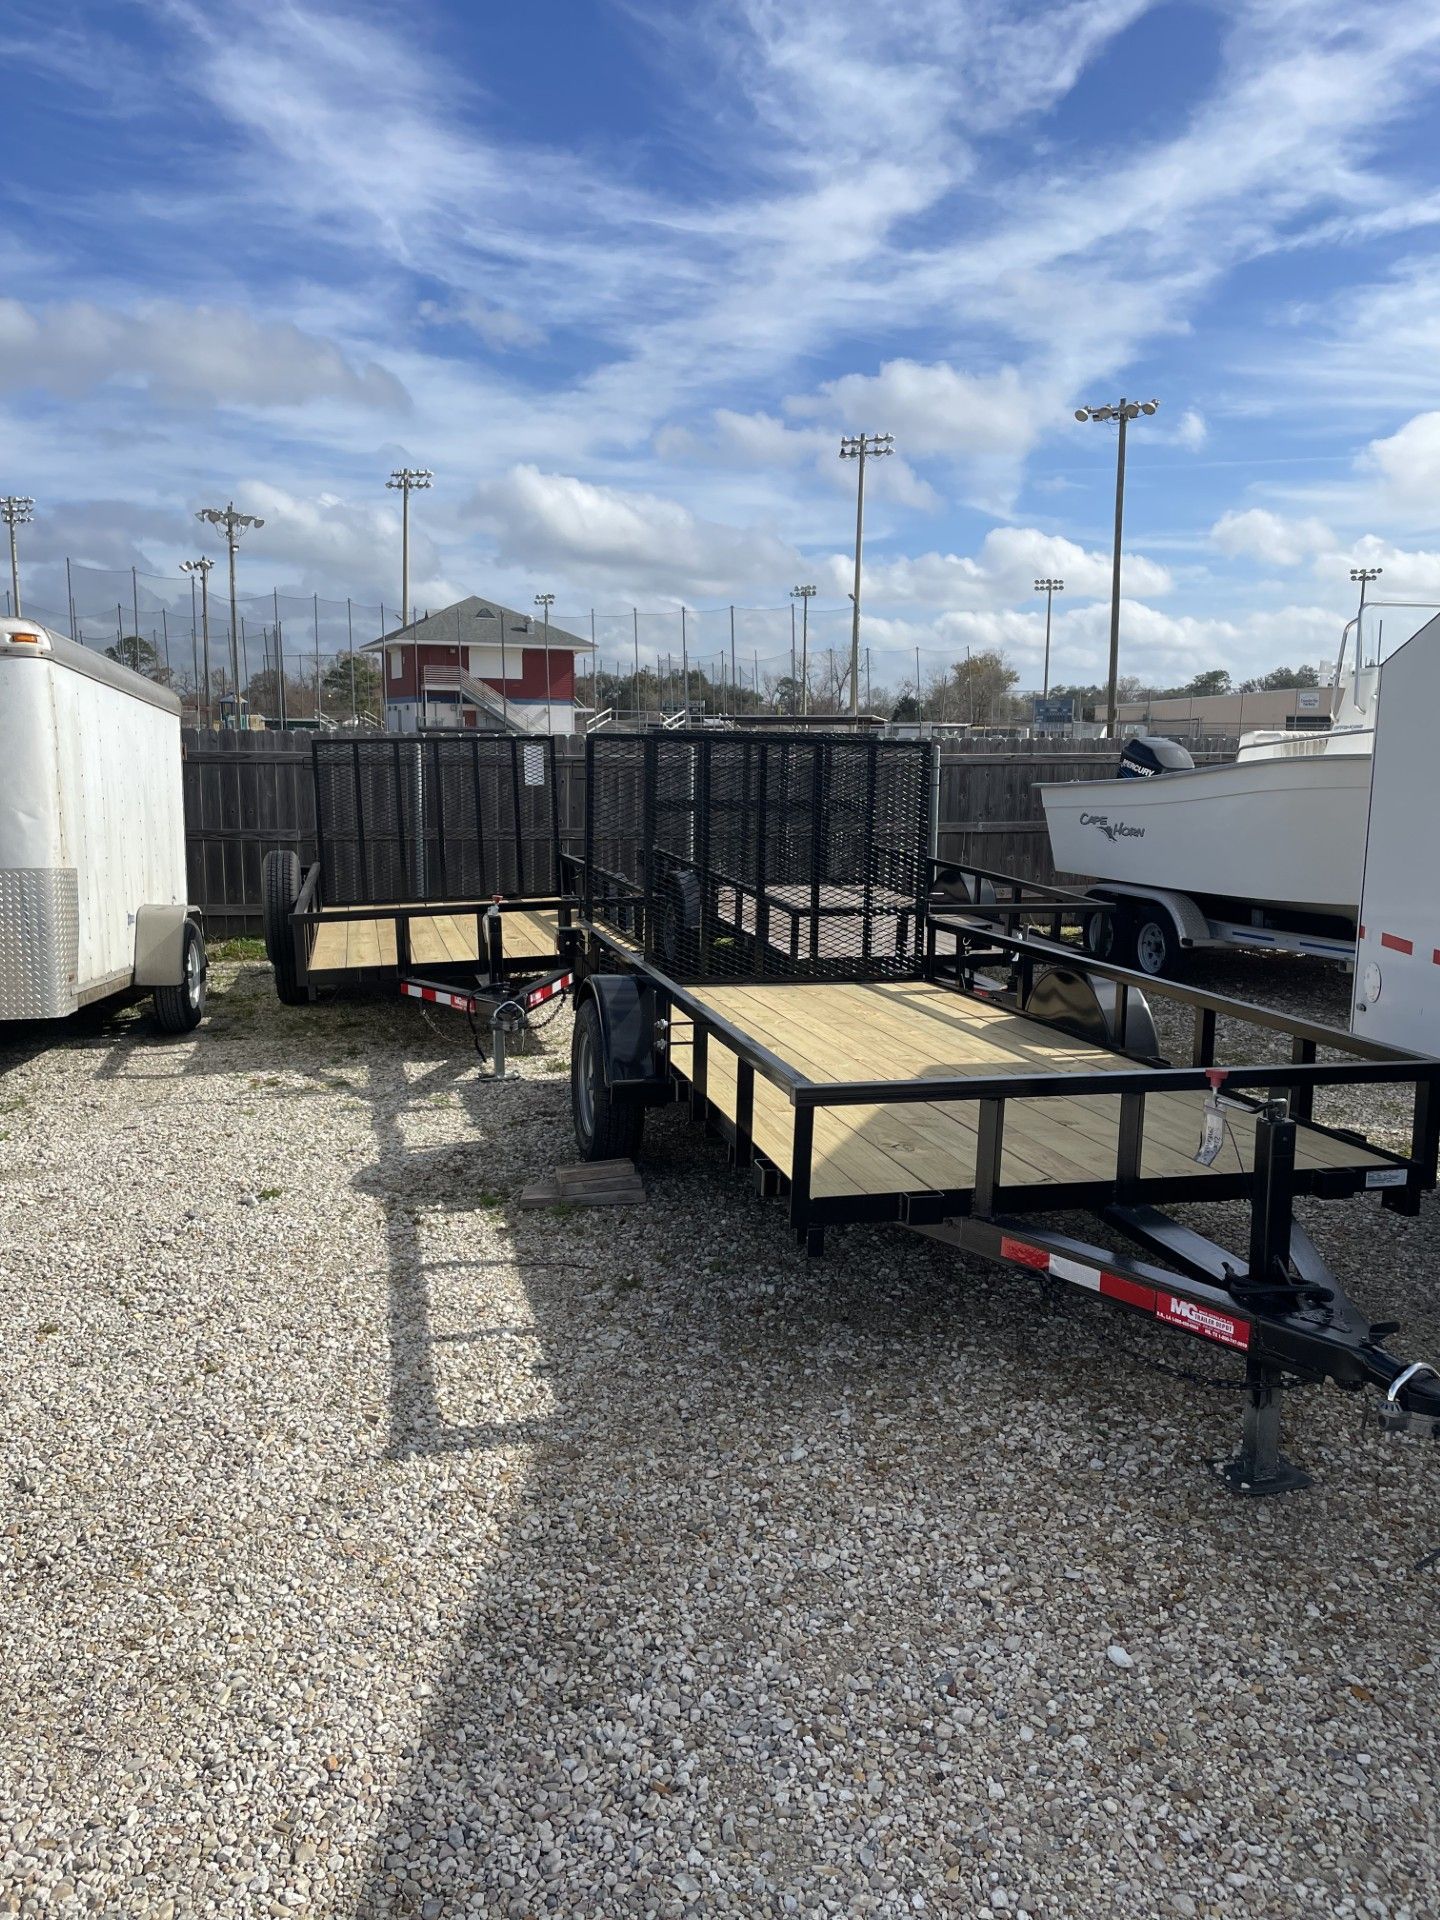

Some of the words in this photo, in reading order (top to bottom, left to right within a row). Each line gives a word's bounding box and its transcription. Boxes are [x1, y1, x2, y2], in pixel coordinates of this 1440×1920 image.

[1122, 758, 1155, 777] MERCURY
[1079, 812, 1108, 826] CAPE
[1113, 822, 1145, 838] HORN
[1170, 1297, 1198, 1320] MG
[1194, 1313, 1215, 1326] TRAILER
